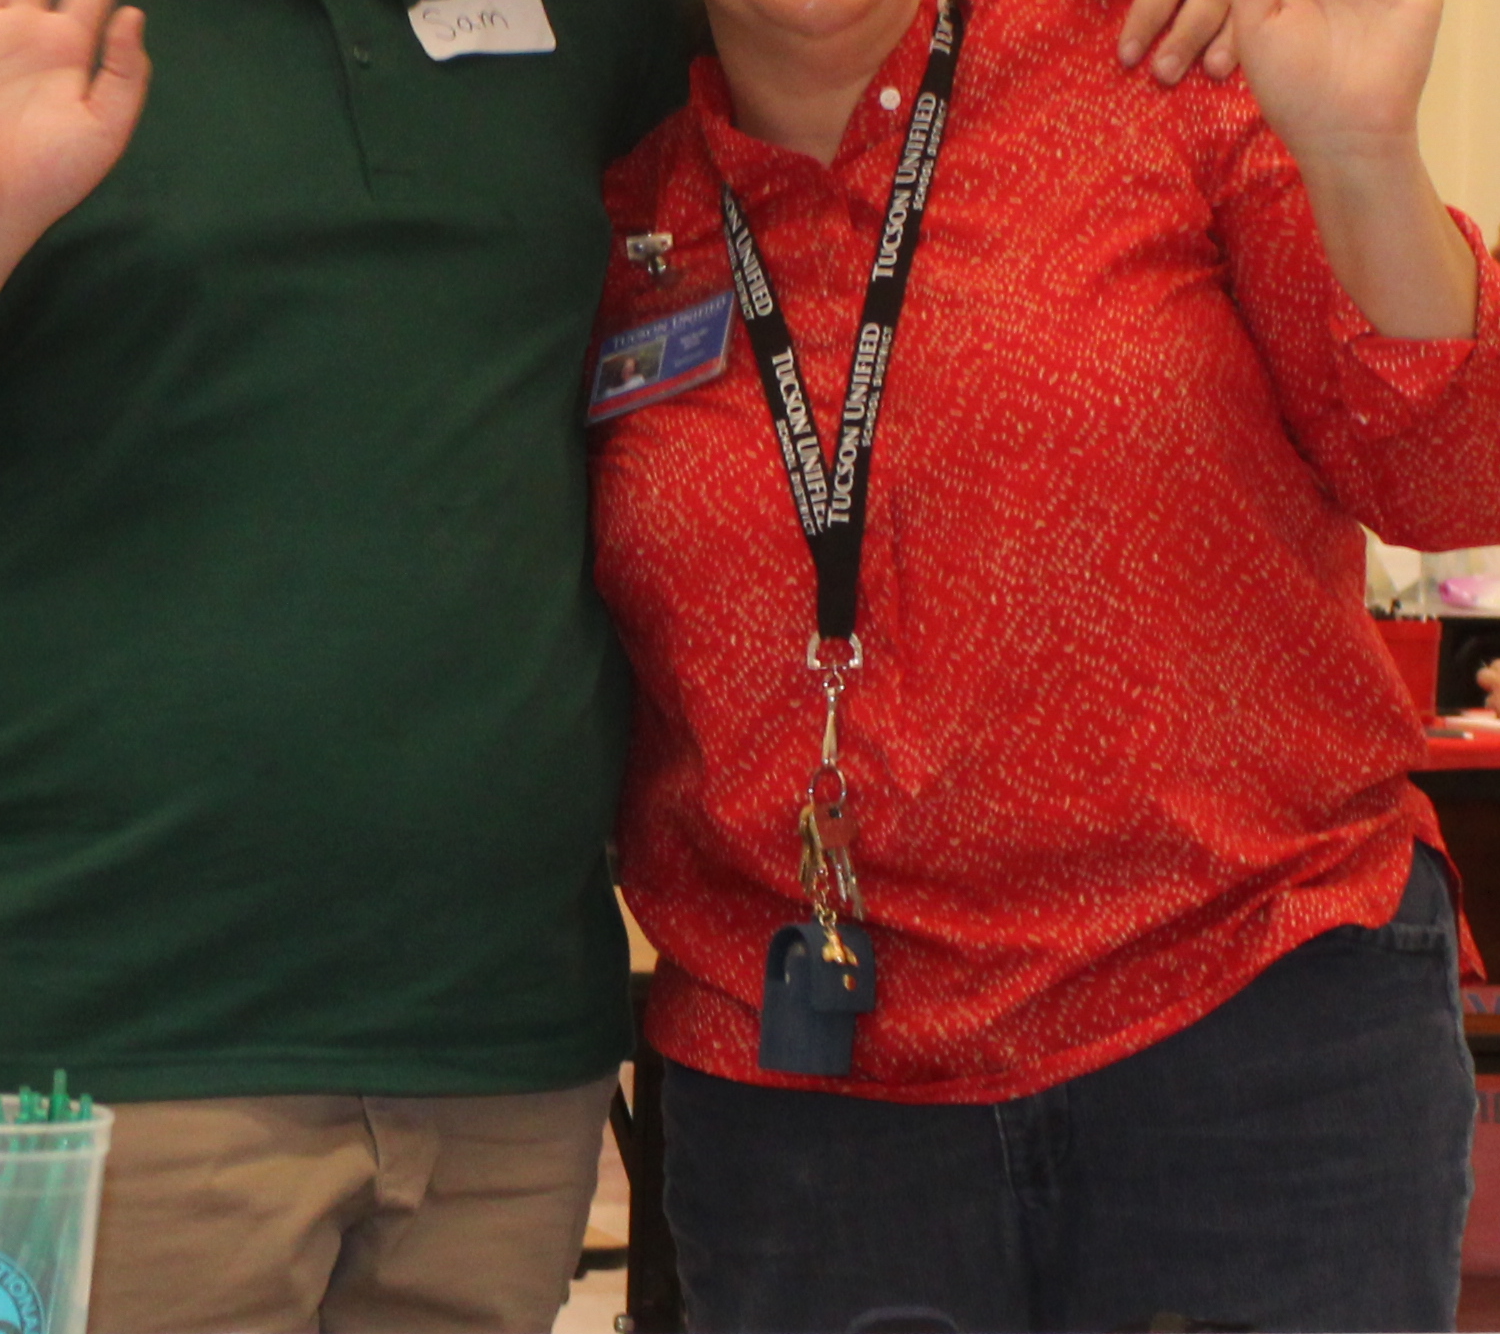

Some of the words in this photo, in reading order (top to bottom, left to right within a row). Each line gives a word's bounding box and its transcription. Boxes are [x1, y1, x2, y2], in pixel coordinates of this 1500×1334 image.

[422, 7, 510, 42] Sam
[873, 177, 913, 282] TUCSON
[897, 91, 937, 184] UNIFIED
[736, 228, 774, 318] UNIFIED
[772, 345, 812, 436] TUCSON
[843, 322, 882, 419] UNIFIED
[826, 417, 861, 529] TUCSON
